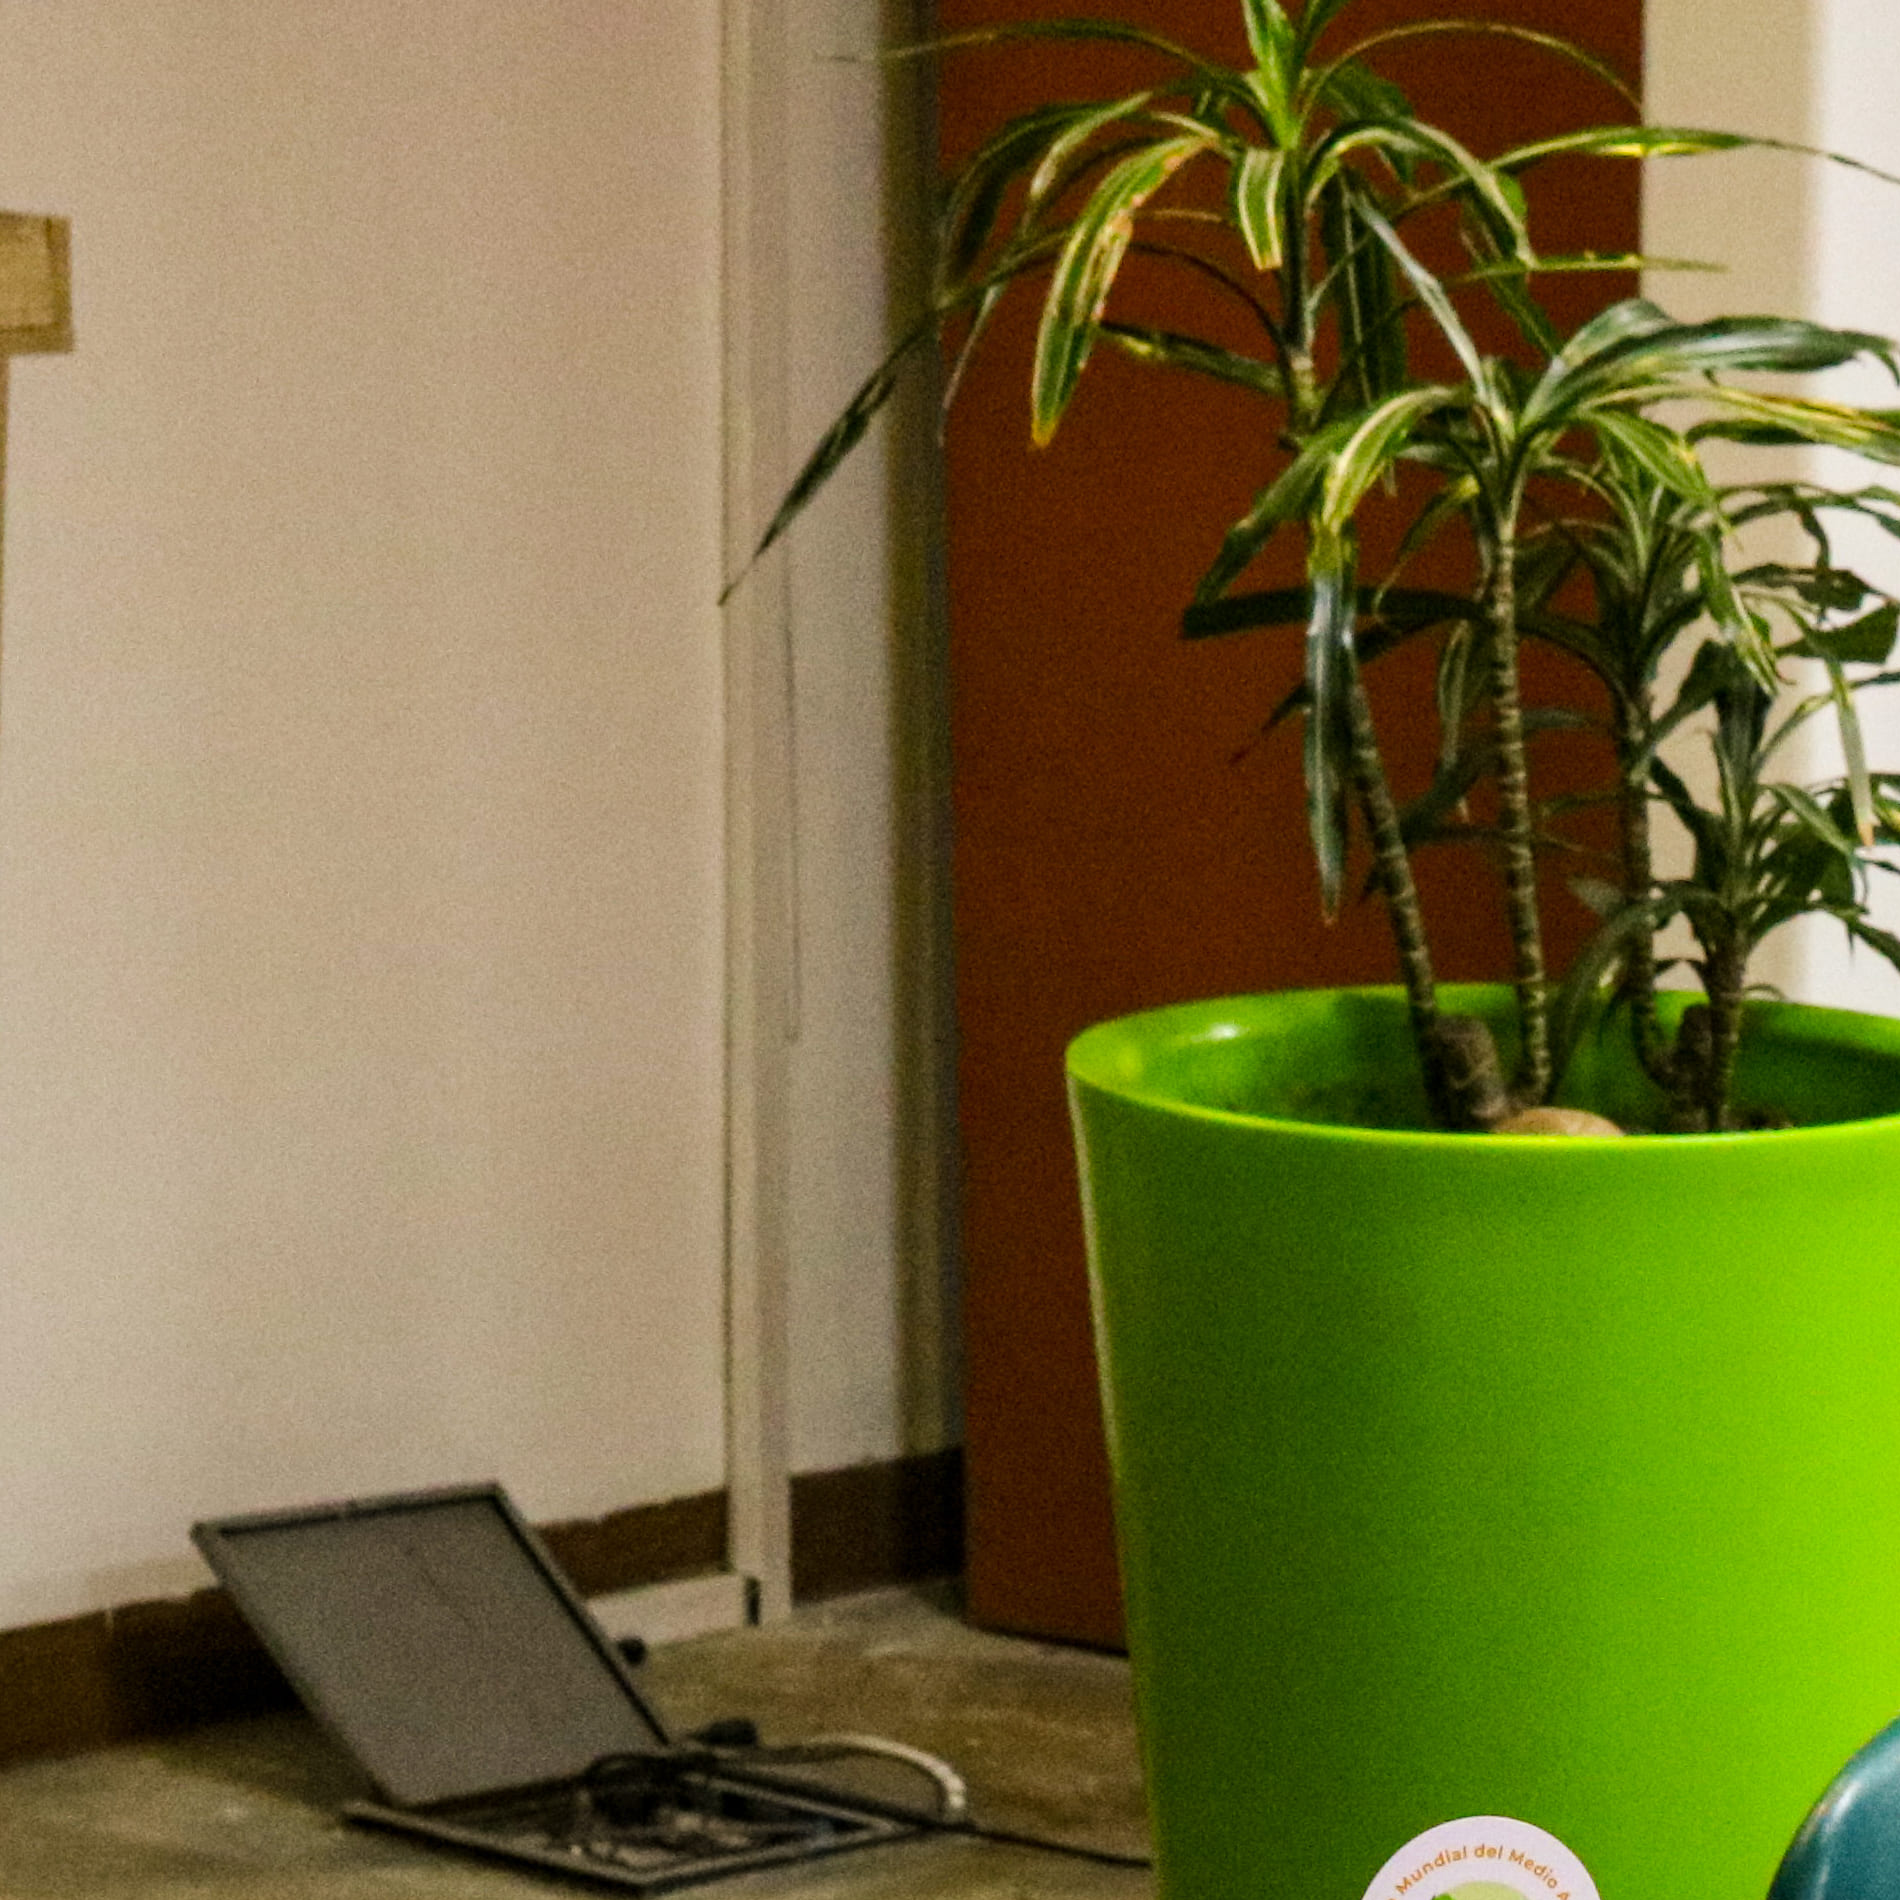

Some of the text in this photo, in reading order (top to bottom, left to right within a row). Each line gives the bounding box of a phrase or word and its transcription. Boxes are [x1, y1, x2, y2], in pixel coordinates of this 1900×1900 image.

[1395, 1845, 1468, 1896] Mundial
[1473, 1843, 1504, 1860] del
[1508, 1848, 1558, 1890] Medio
